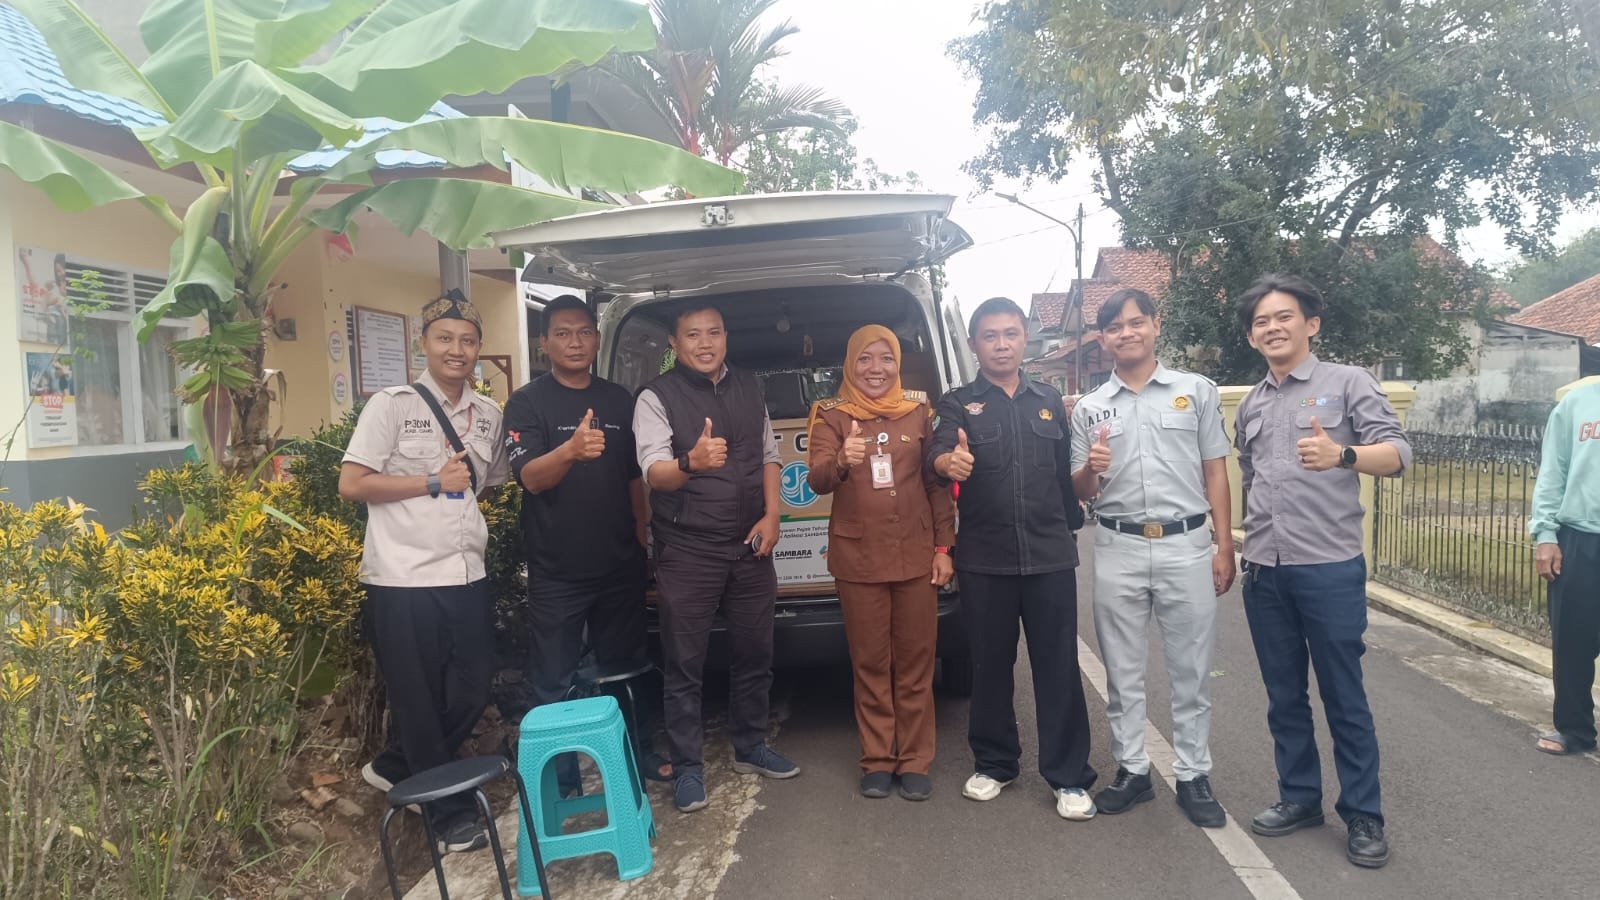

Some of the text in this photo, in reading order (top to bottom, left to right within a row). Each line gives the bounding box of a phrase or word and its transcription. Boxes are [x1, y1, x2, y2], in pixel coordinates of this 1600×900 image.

[43, 395, 63, 406] STOP
[1088, 407, 1117, 427] ALDI
[774, 549, 812, 557] SAMBARA
